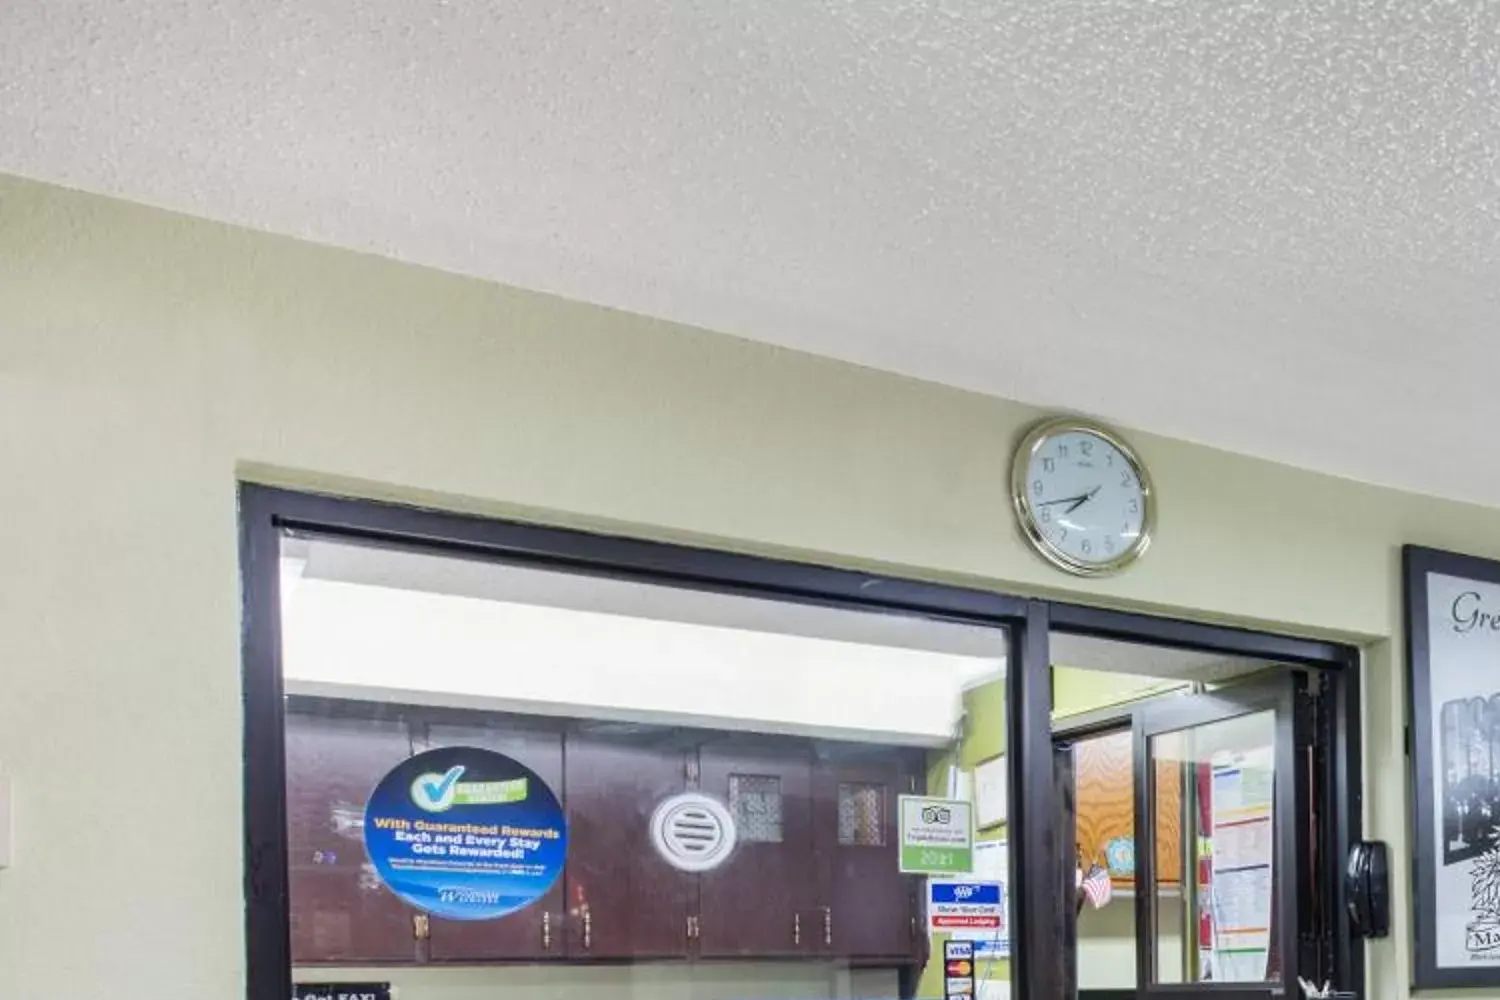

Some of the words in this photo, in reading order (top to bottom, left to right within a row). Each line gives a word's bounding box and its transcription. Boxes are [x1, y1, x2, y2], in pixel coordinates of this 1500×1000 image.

[374, 817, 410, 830] With
[414, 820, 498, 835] Guaranteed
[501, 825, 560, 839] Rewards
[395, 831, 431, 843] Each
[435, 834, 462, 845] and
[465, 835, 507, 850] Every
[510, 838, 541, 851] Stay
[411, 843, 447, 856] Gets
[449, 845, 525, 860] Rewarded!
